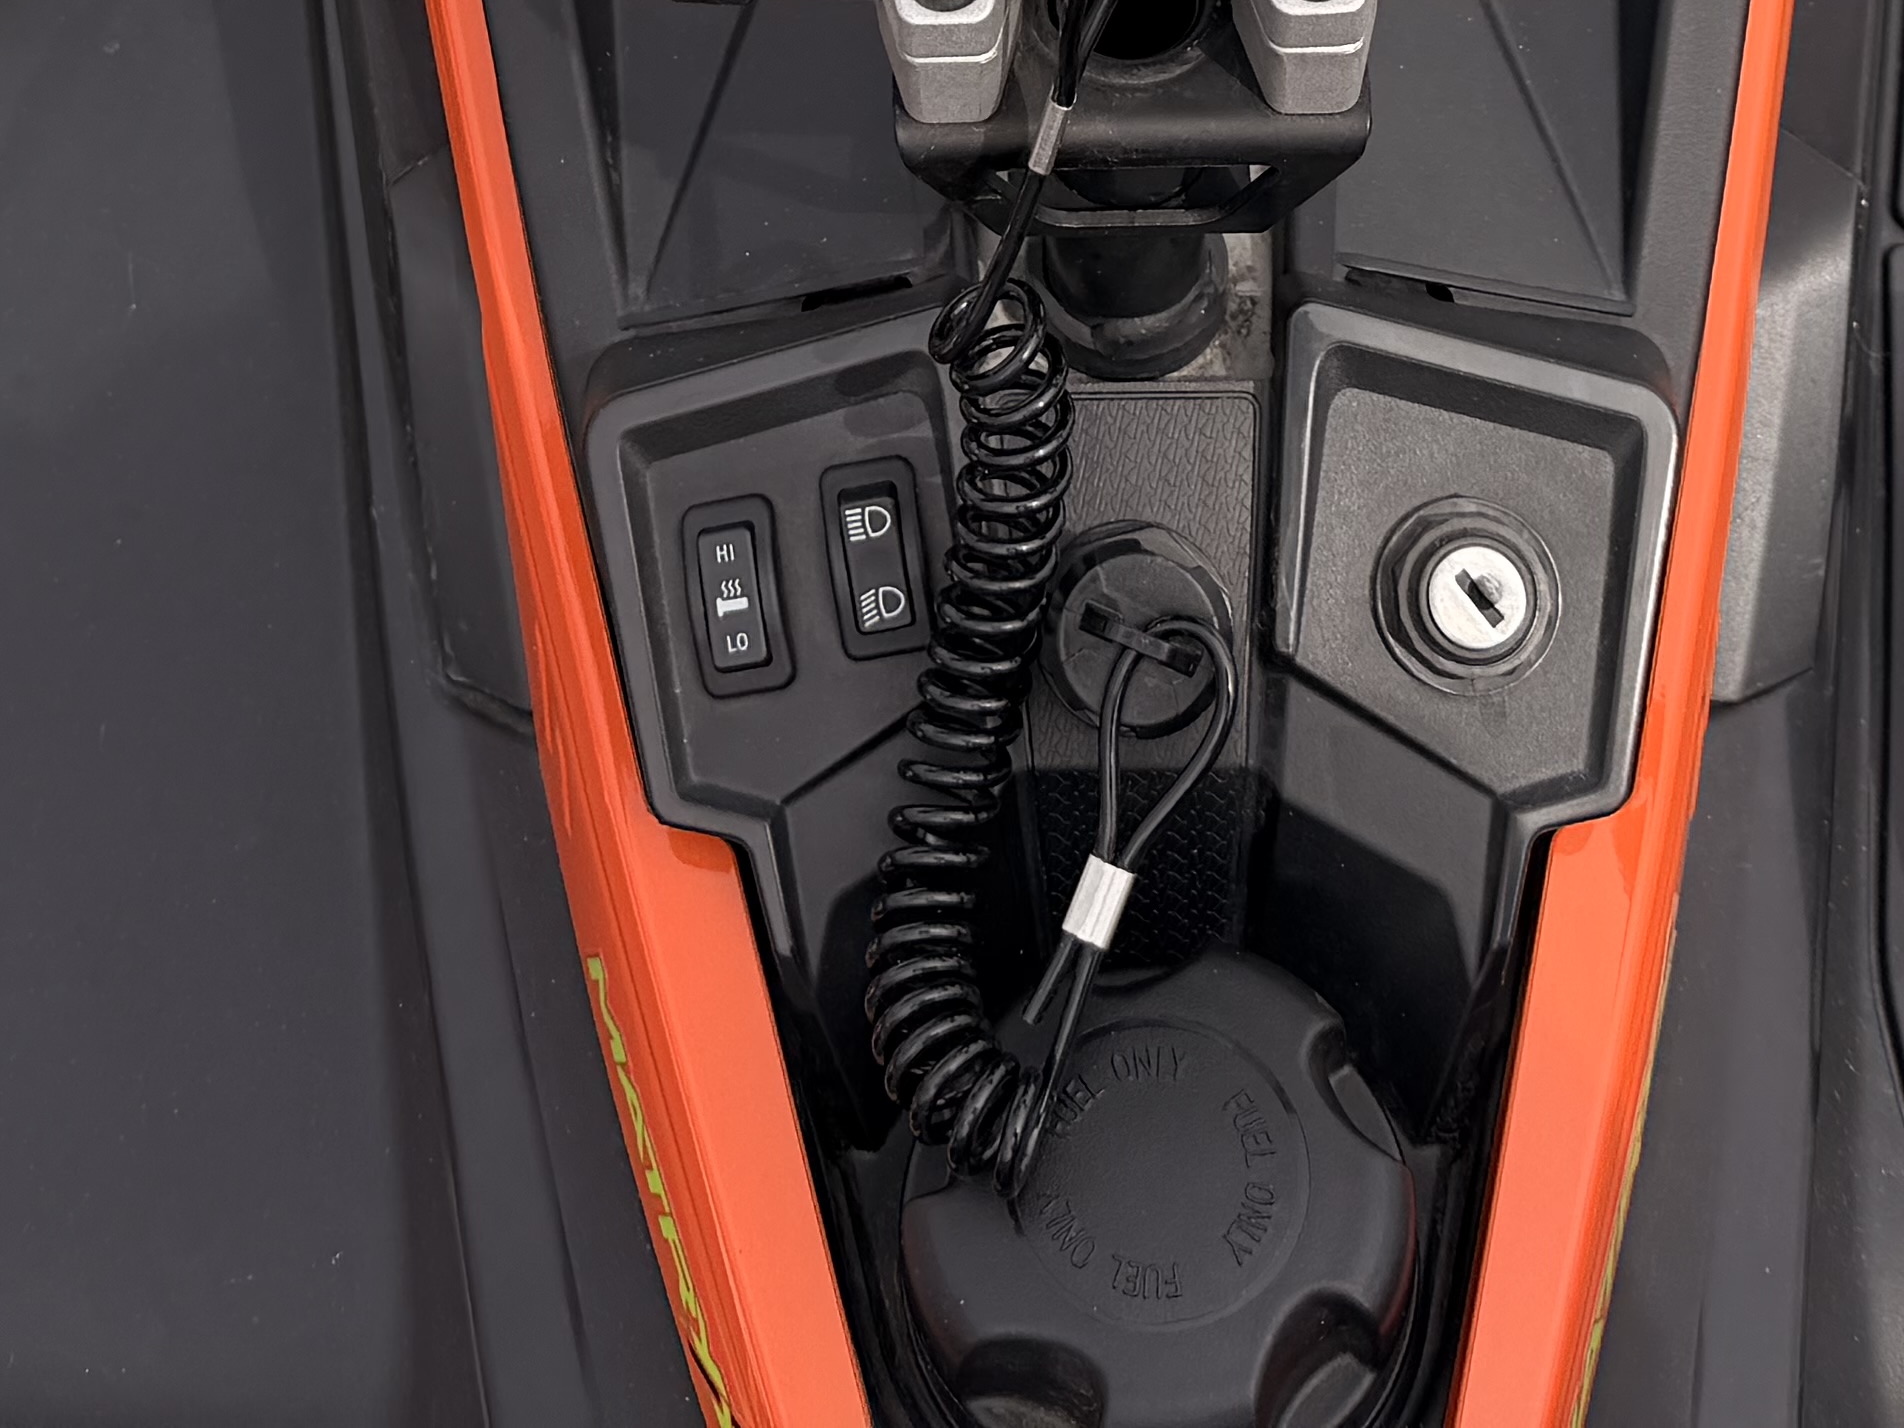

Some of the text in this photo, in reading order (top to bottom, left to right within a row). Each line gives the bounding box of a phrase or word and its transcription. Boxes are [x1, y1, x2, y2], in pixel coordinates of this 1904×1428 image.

[715, 543, 735, 563] HI
[726, 632, 749, 653] LO
[1110, 1046, 1187, 1082] ONLY
[1222, 1089, 1277, 1267] FUEL ONLY
[1112, 1254, 1184, 1300] FUEL
